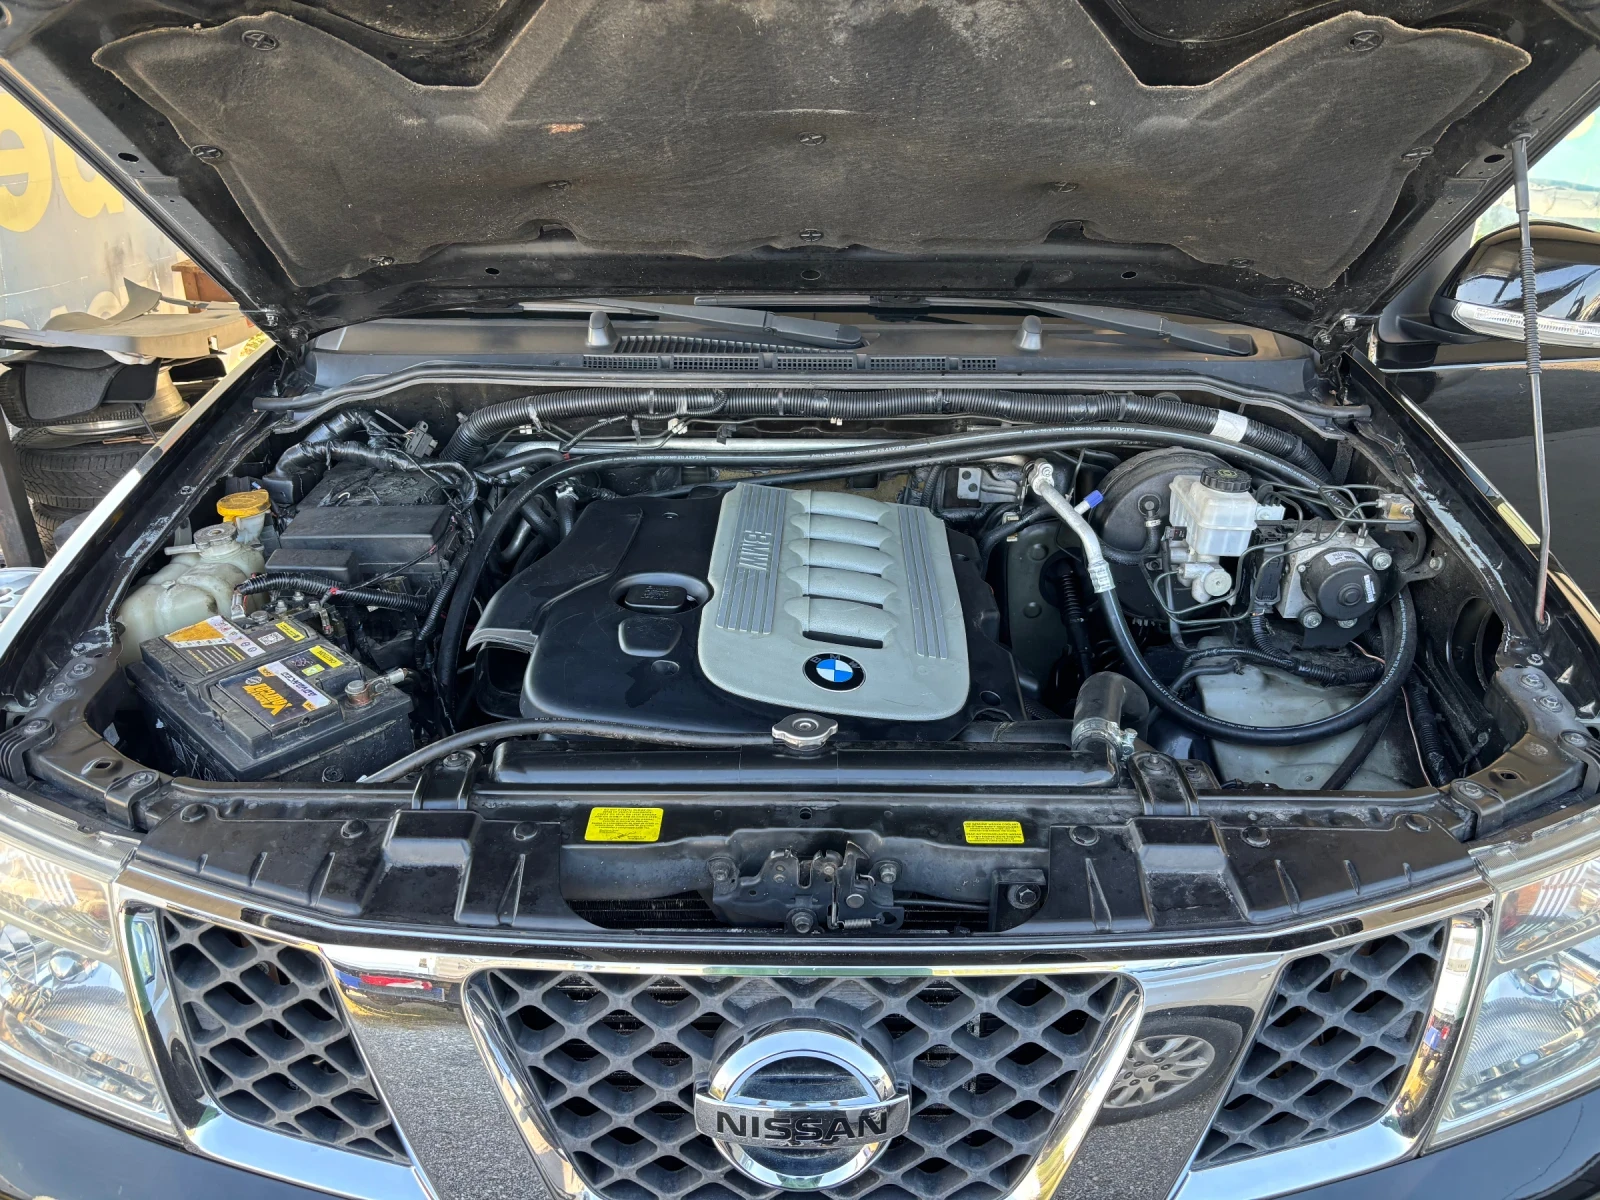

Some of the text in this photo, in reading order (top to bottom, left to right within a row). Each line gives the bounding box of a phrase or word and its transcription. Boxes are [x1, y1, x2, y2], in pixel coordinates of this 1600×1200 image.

[739, 530, 772, 571] BMW
[810, 653, 861, 669] BMW
[716, 1111, 887, 1140] NISSAN
